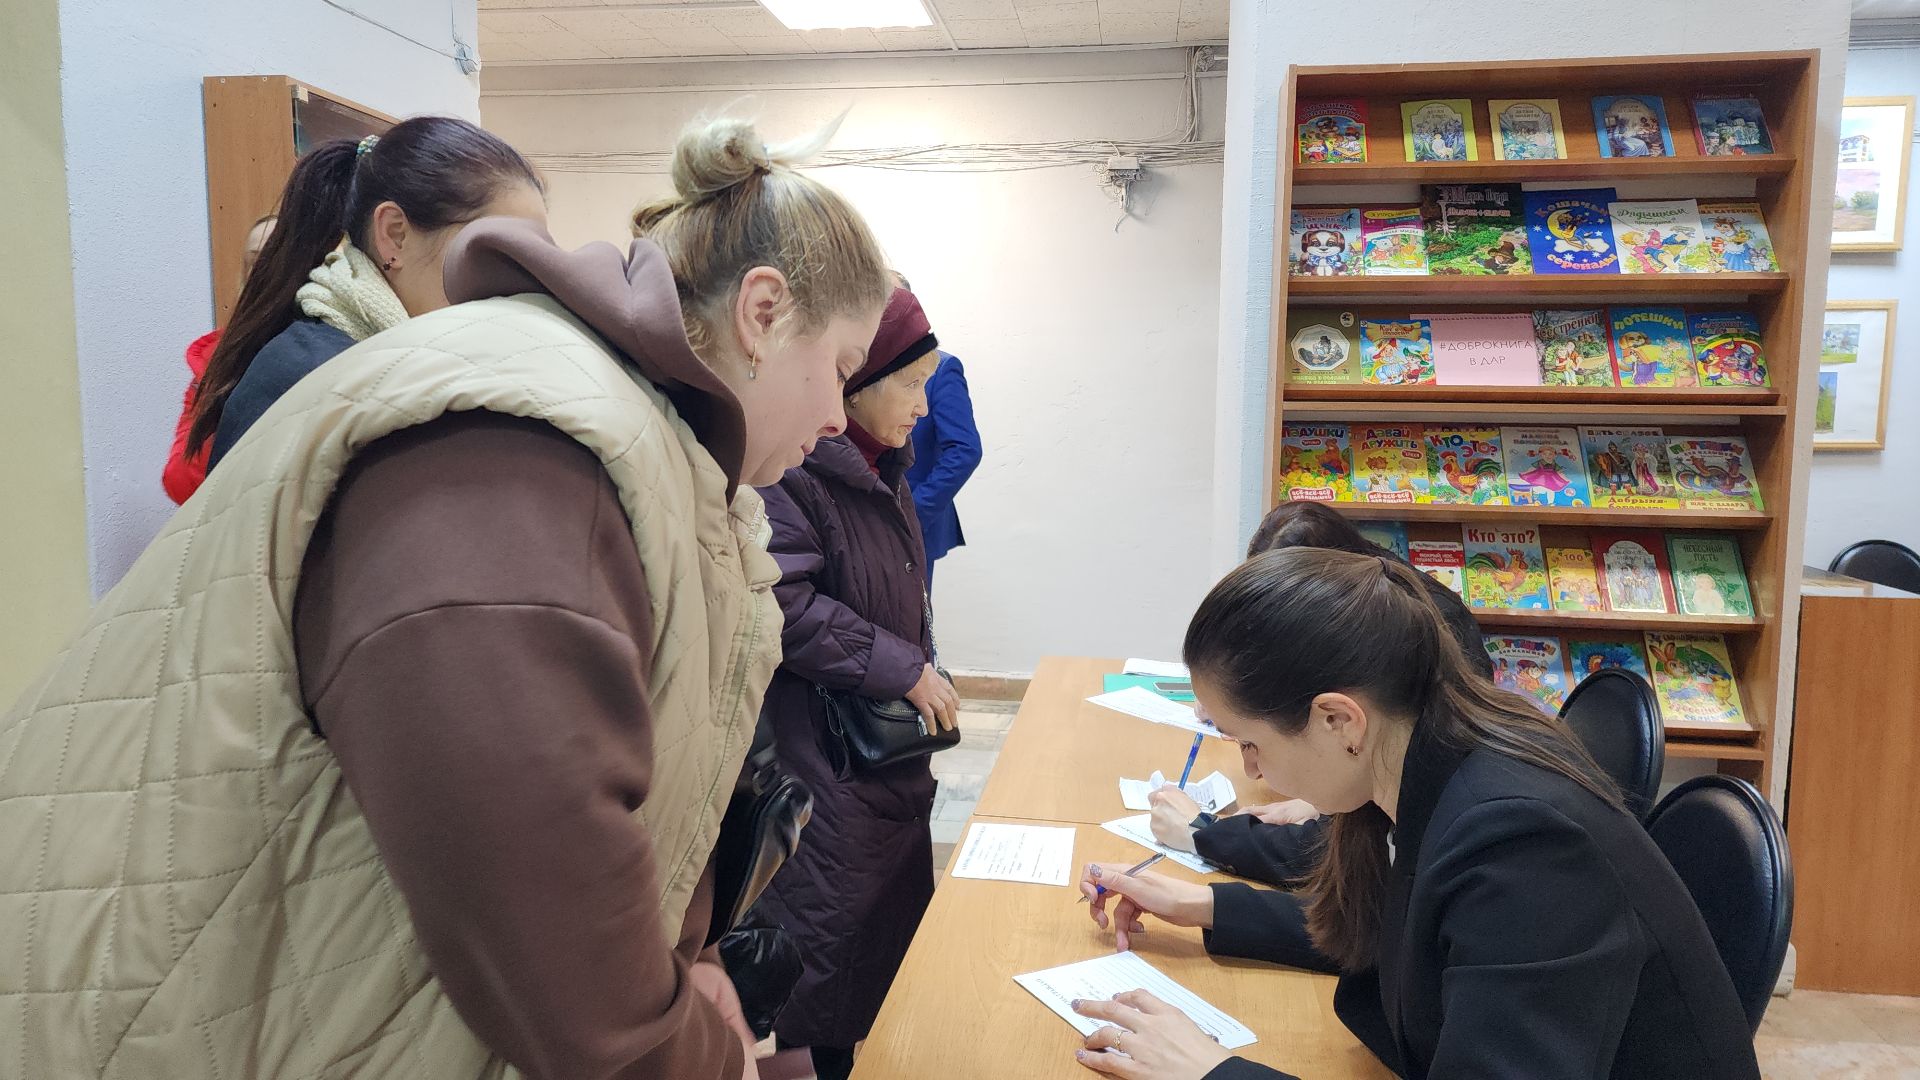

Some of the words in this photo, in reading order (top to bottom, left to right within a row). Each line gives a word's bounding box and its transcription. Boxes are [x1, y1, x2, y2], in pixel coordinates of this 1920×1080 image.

[1614, 313, 1685, 331] ПОТЕШКИ
[1440, 340, 1533, 352] #ДОБРОКНИГА
[1469, 357, 1477, 366] В
[1480, 356, 1506, 366] ДАР
[1468, 528, 1497, 543] Кто
[1501, 529, 1536, 544] это?
[1563, 553, 1584, 562] 100
